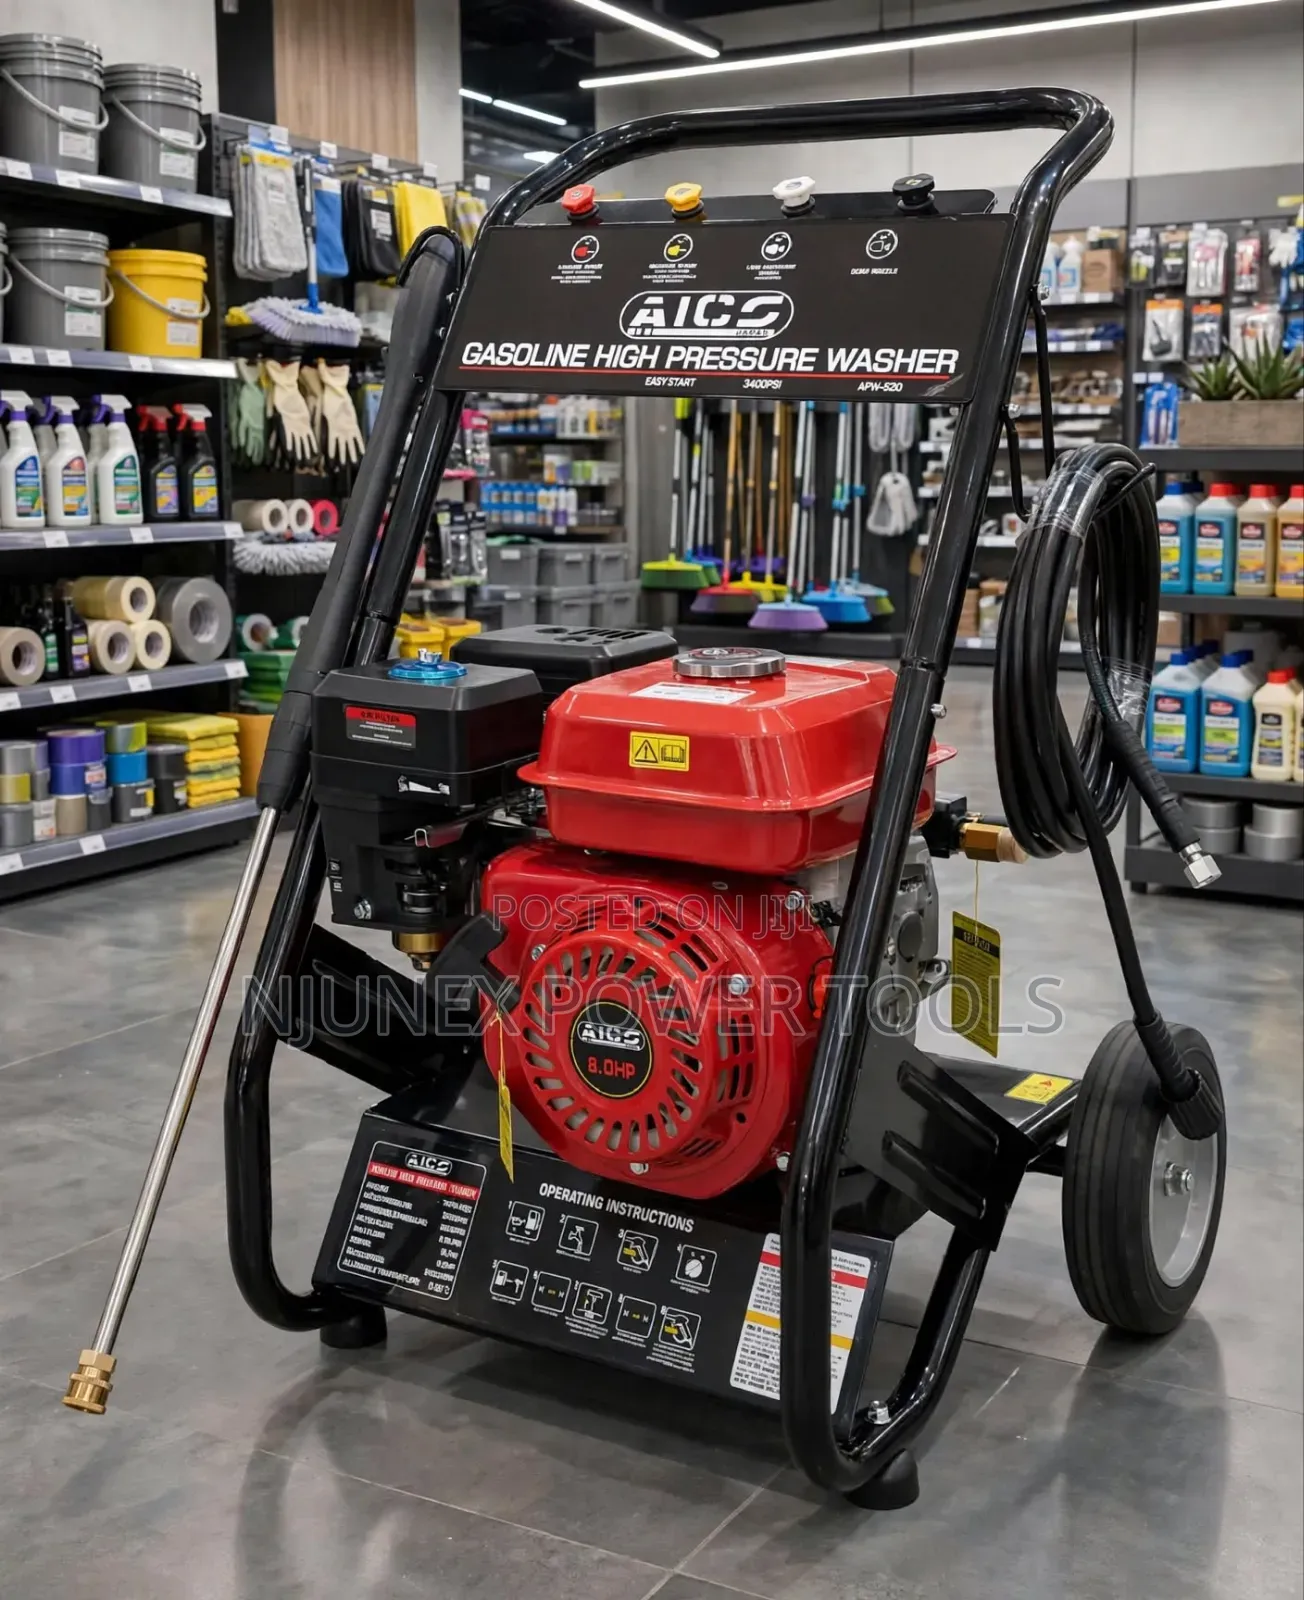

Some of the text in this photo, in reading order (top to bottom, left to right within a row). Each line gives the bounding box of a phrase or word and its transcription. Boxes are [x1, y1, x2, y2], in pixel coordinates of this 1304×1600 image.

[628, 294, 785, 328] AICS
[461, 341, 960, 374] GASOLINE HIGH PRESSURE WASHER
[644, 376, 697, 387] EASY START
[742, 378, 783, 390] 3400PSI
[857, 381, 904, 392] APW-520
[581, 1023, 640, 1046] AICS
[587, 1056, 636, 1080] 8.0HP
[407, 1154, 450, 1172] AICS
[538, 1182, 695, 1234] OPERATING INSTRUCTIONS
[559, 1213, 566, 1224] 2
[618, 1228, 625, 1239] 3
